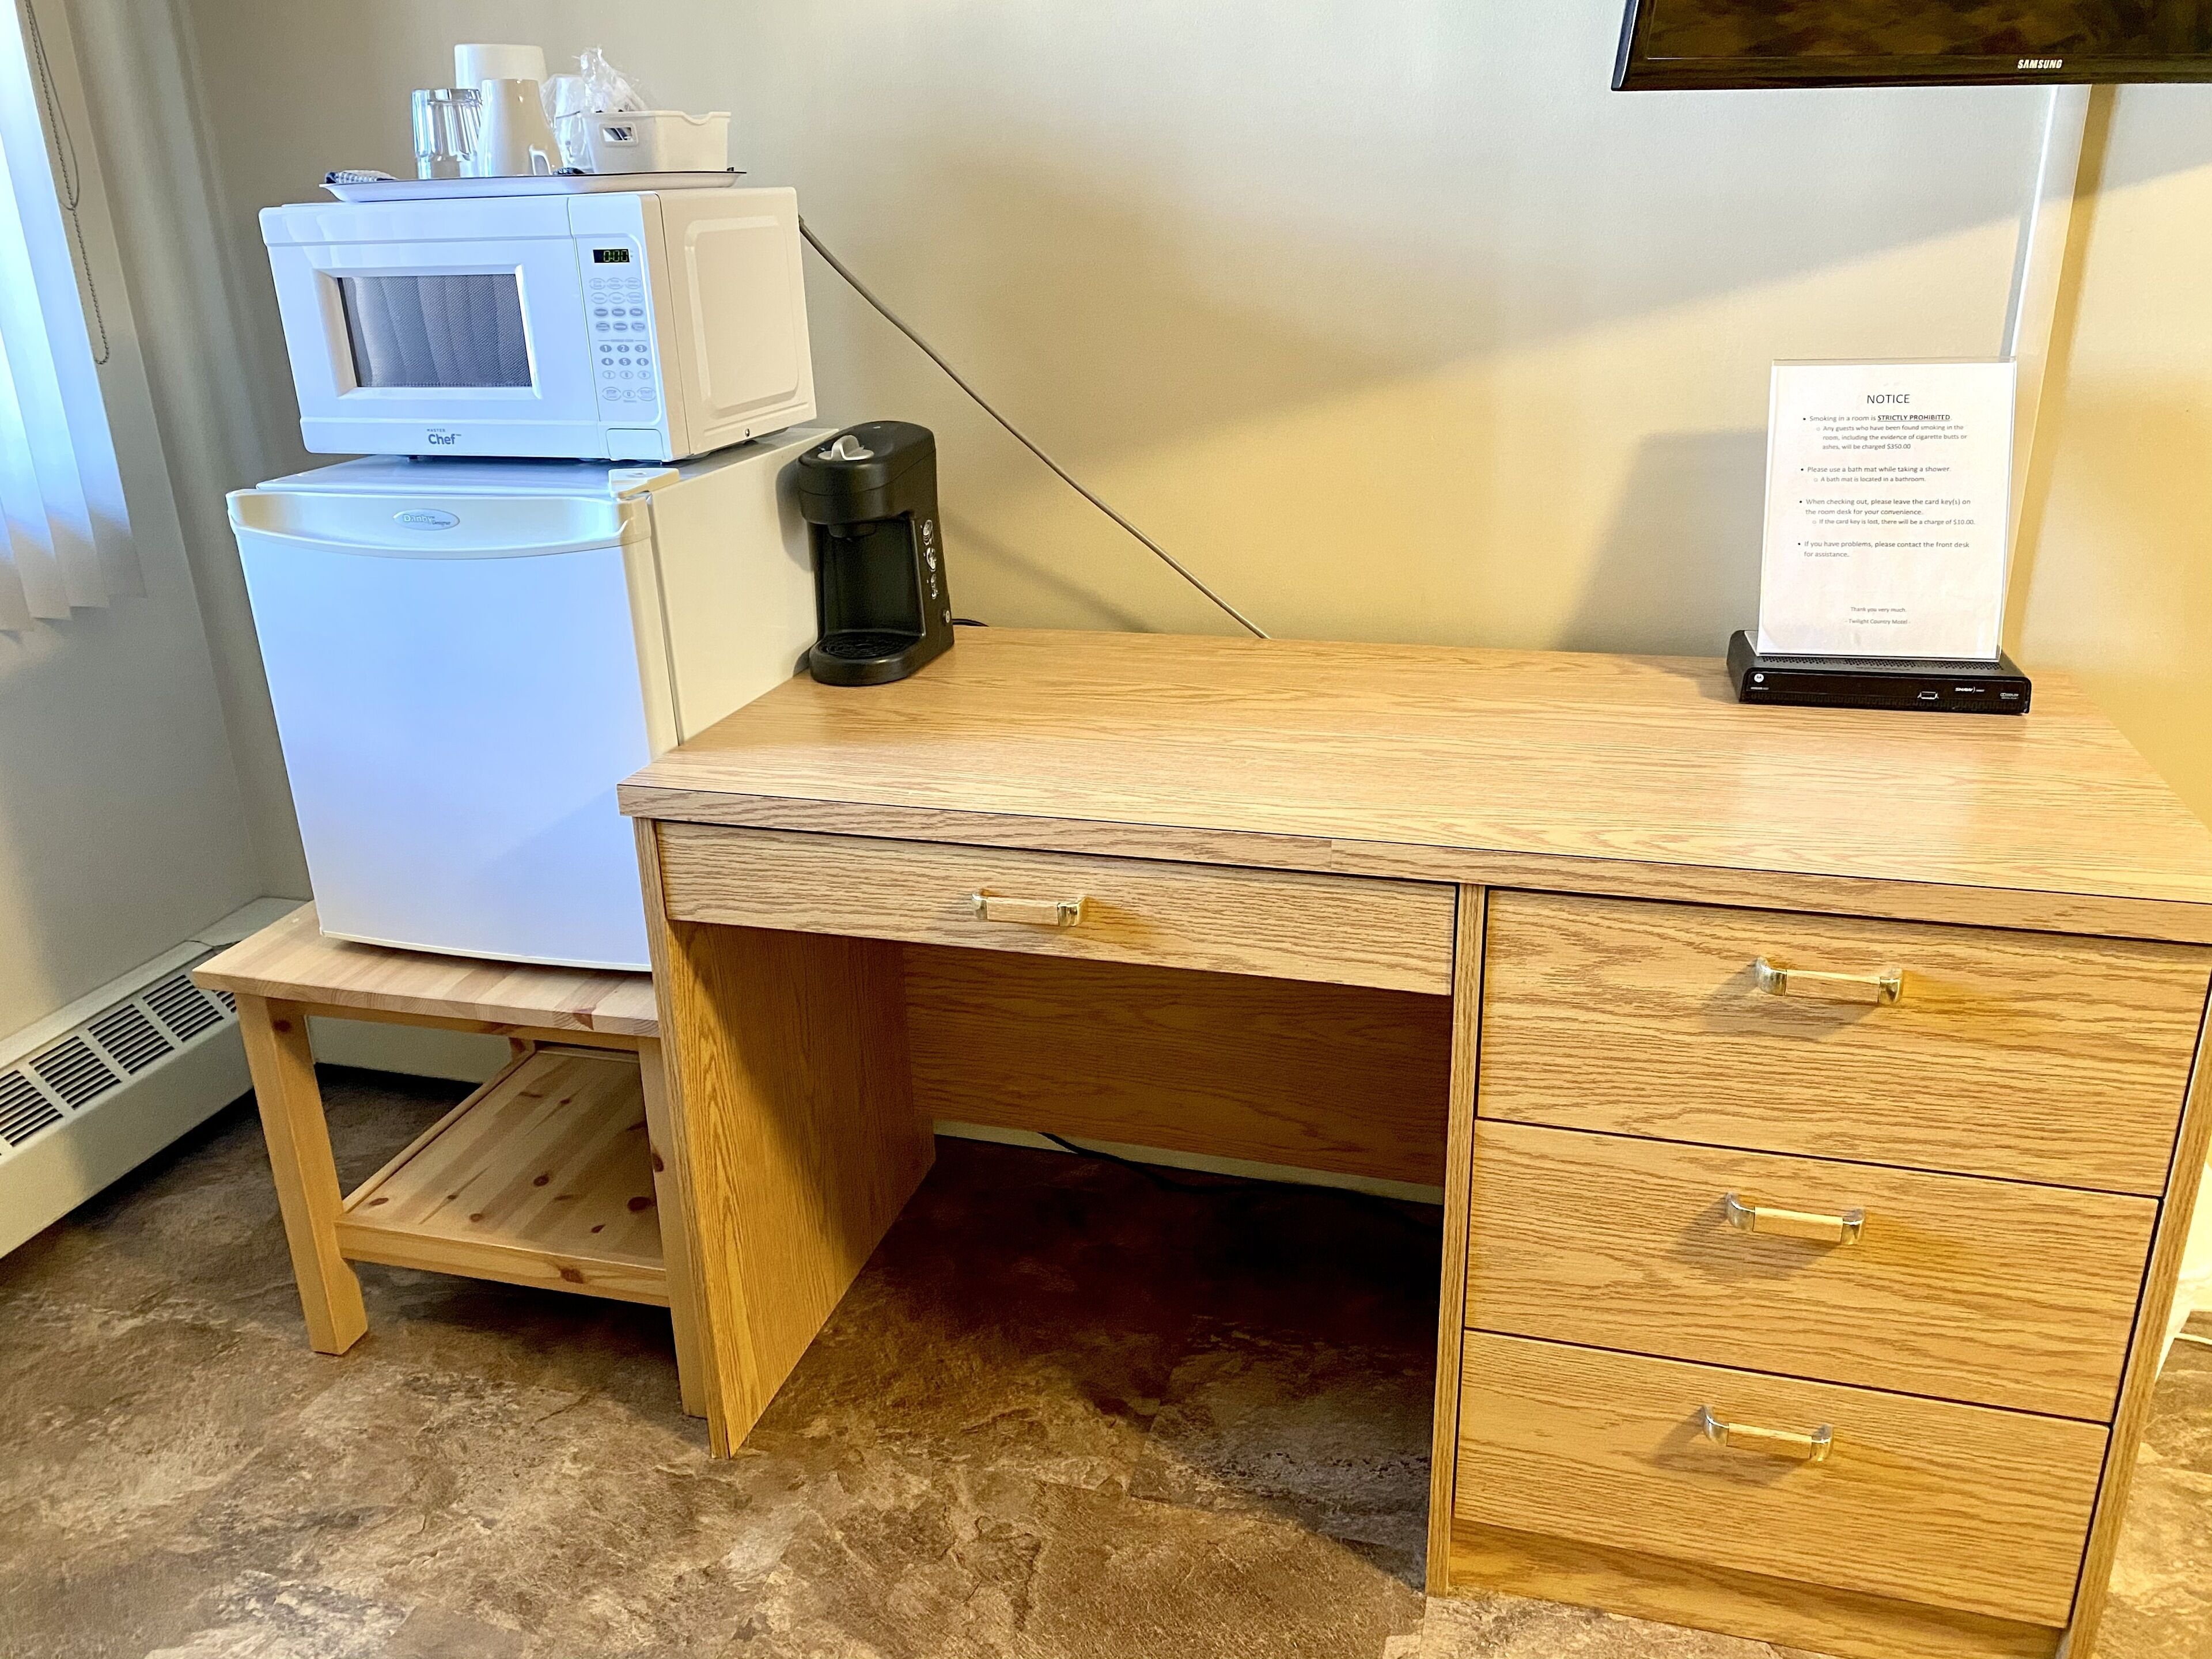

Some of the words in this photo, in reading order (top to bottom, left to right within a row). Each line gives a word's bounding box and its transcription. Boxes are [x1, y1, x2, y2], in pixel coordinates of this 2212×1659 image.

[2017, 59, 2062, 69] SAMSUNG
[1867, 394, 1910, 404] NOTICE
[428, 433, 455, 444] Chef
